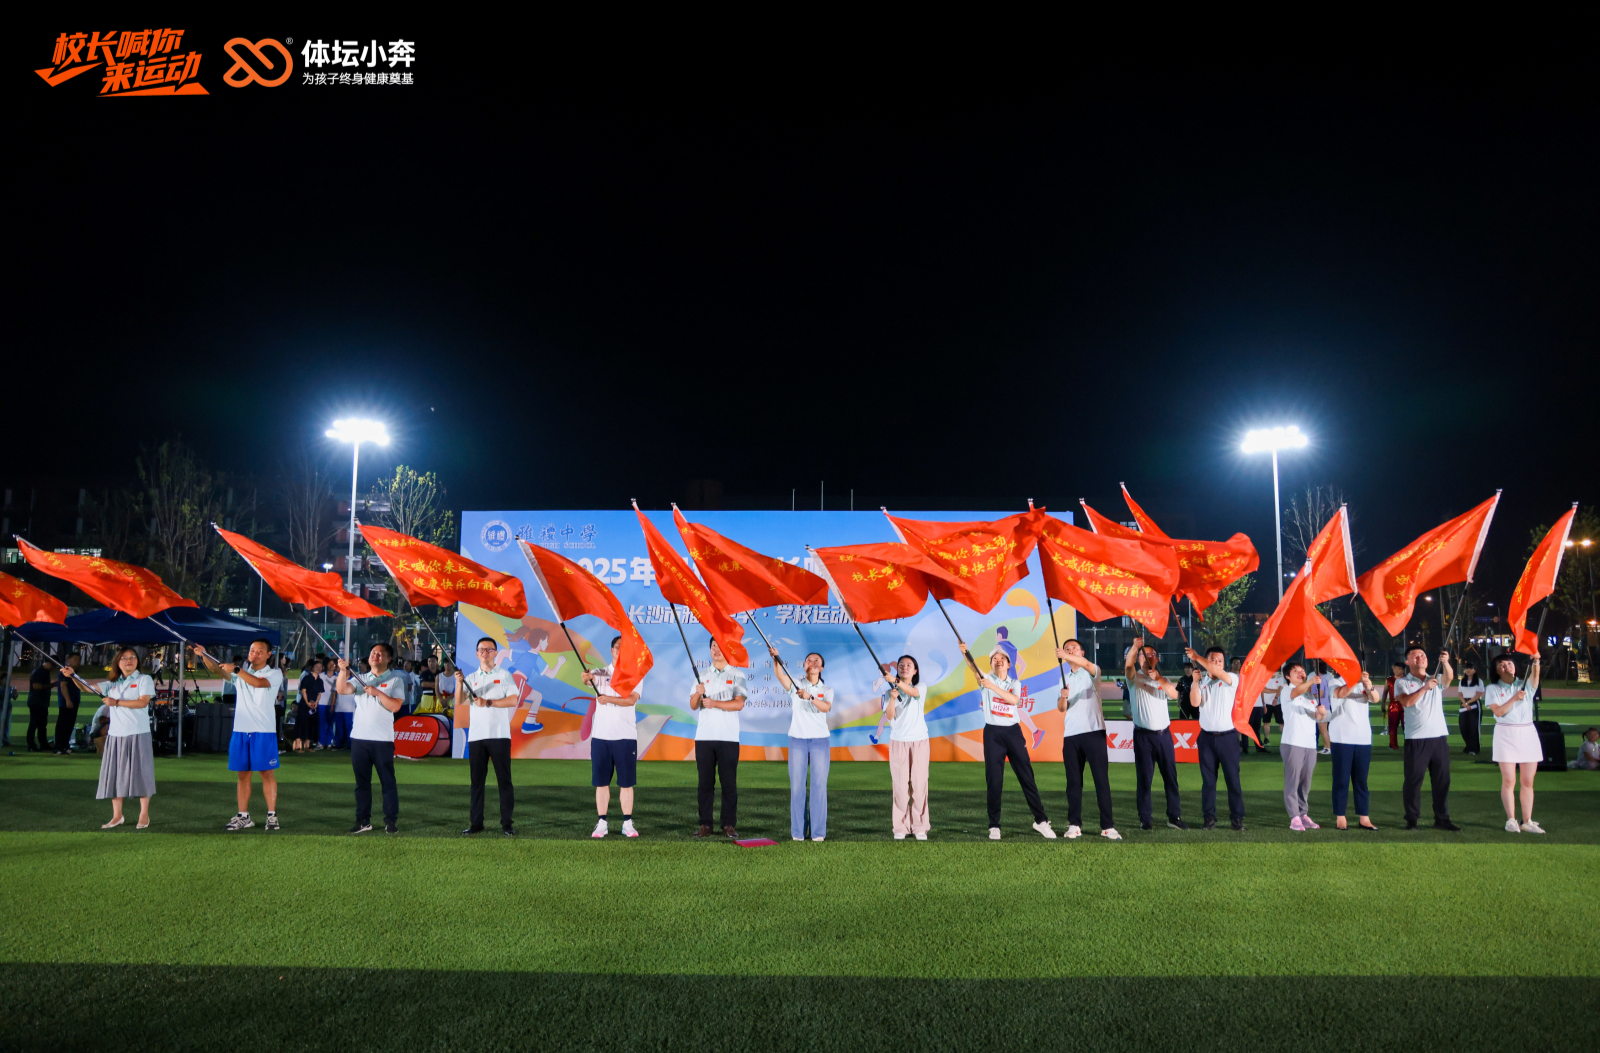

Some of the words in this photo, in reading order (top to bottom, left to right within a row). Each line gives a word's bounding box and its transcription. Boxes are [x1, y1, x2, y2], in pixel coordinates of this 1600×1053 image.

[576, 556, 657, 588] 025年
[1068, 576, 1152, 599] 康快乐向前冲
